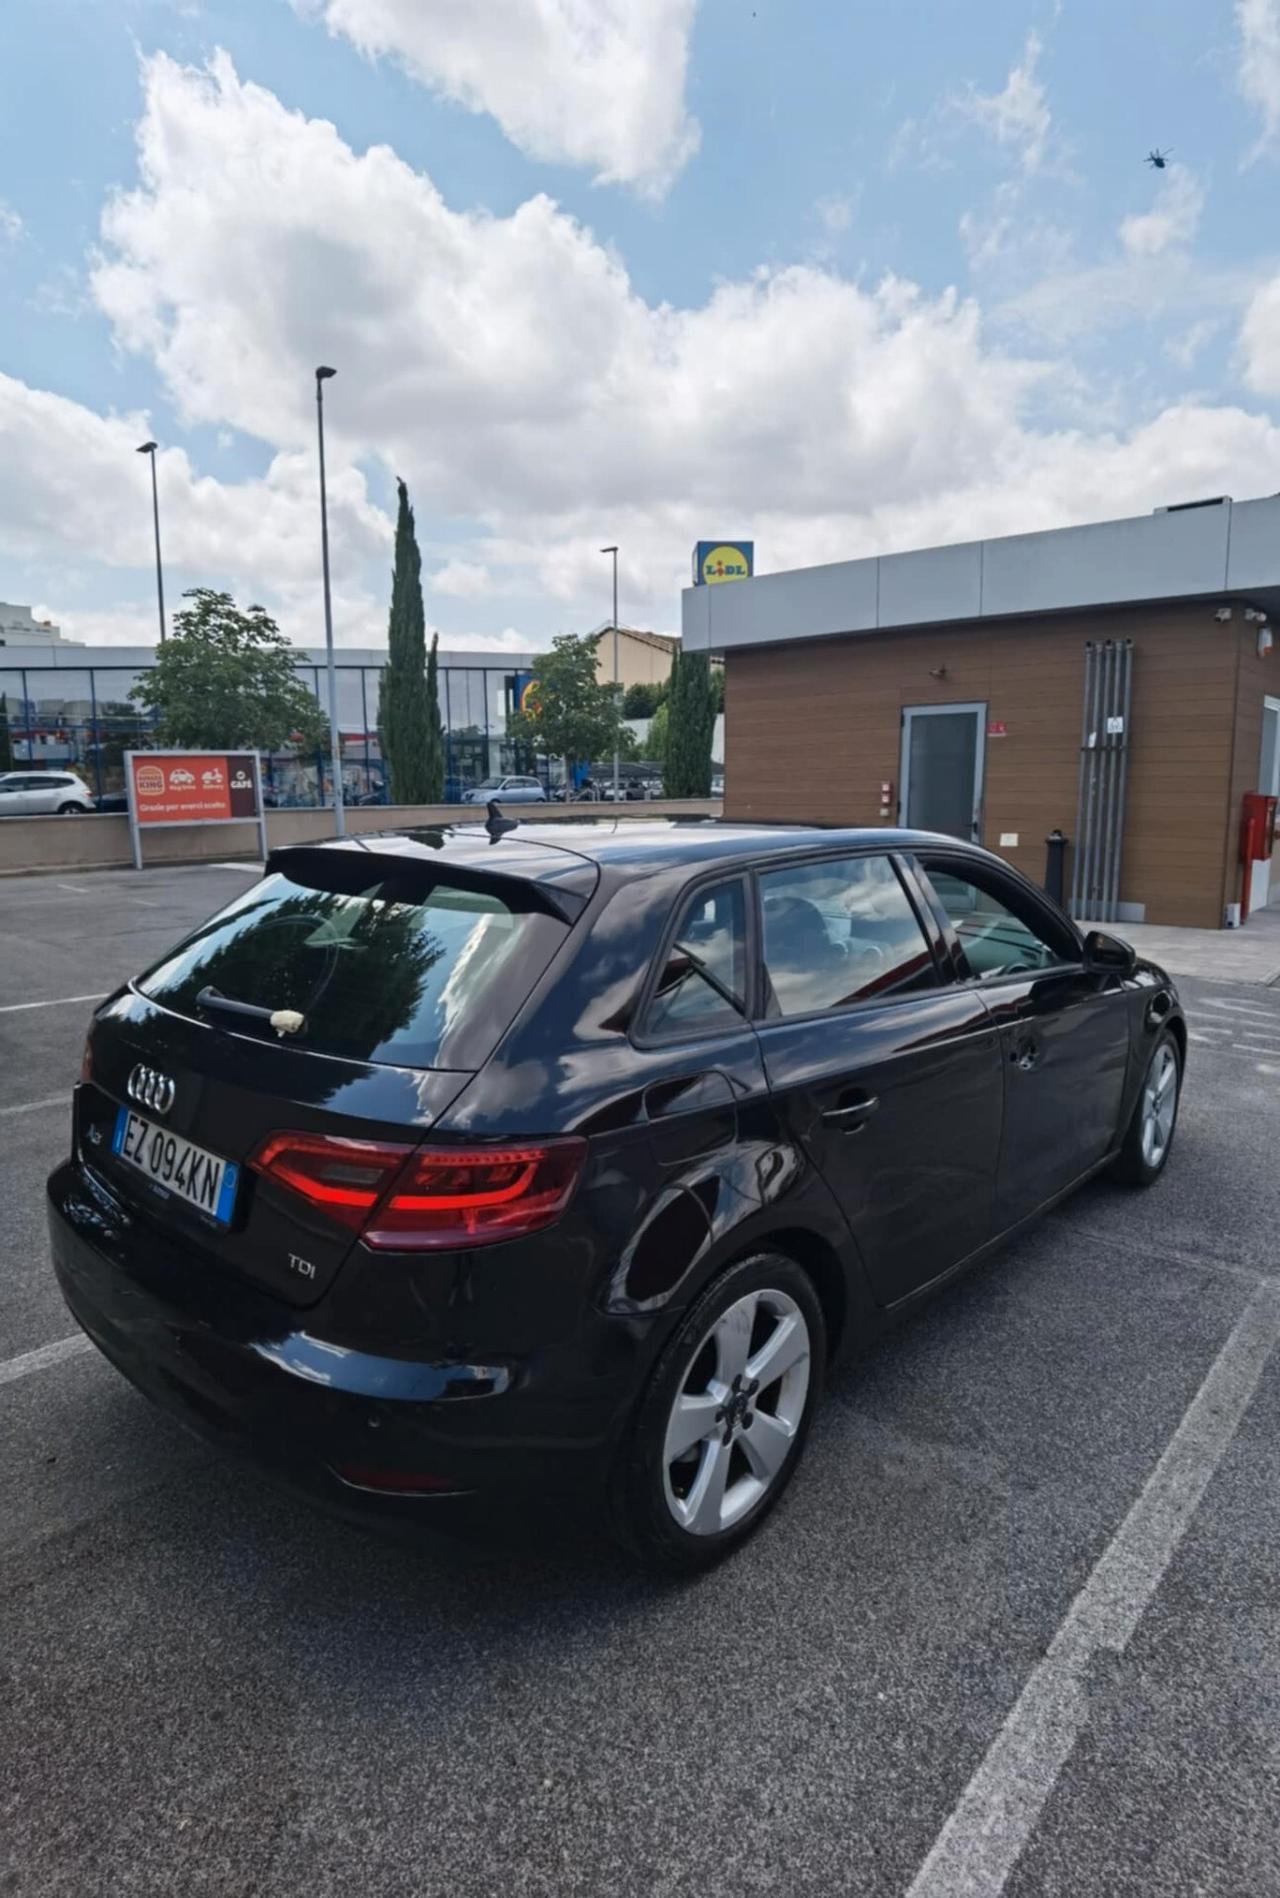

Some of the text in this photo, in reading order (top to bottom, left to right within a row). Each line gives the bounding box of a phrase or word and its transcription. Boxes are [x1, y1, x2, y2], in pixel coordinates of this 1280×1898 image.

[139, 780, 163, 789] KING
[140, 803, 165, 812] Grazie
[165, 804, 179, 813] per
[288, 1252, 316, 1279] TDI
